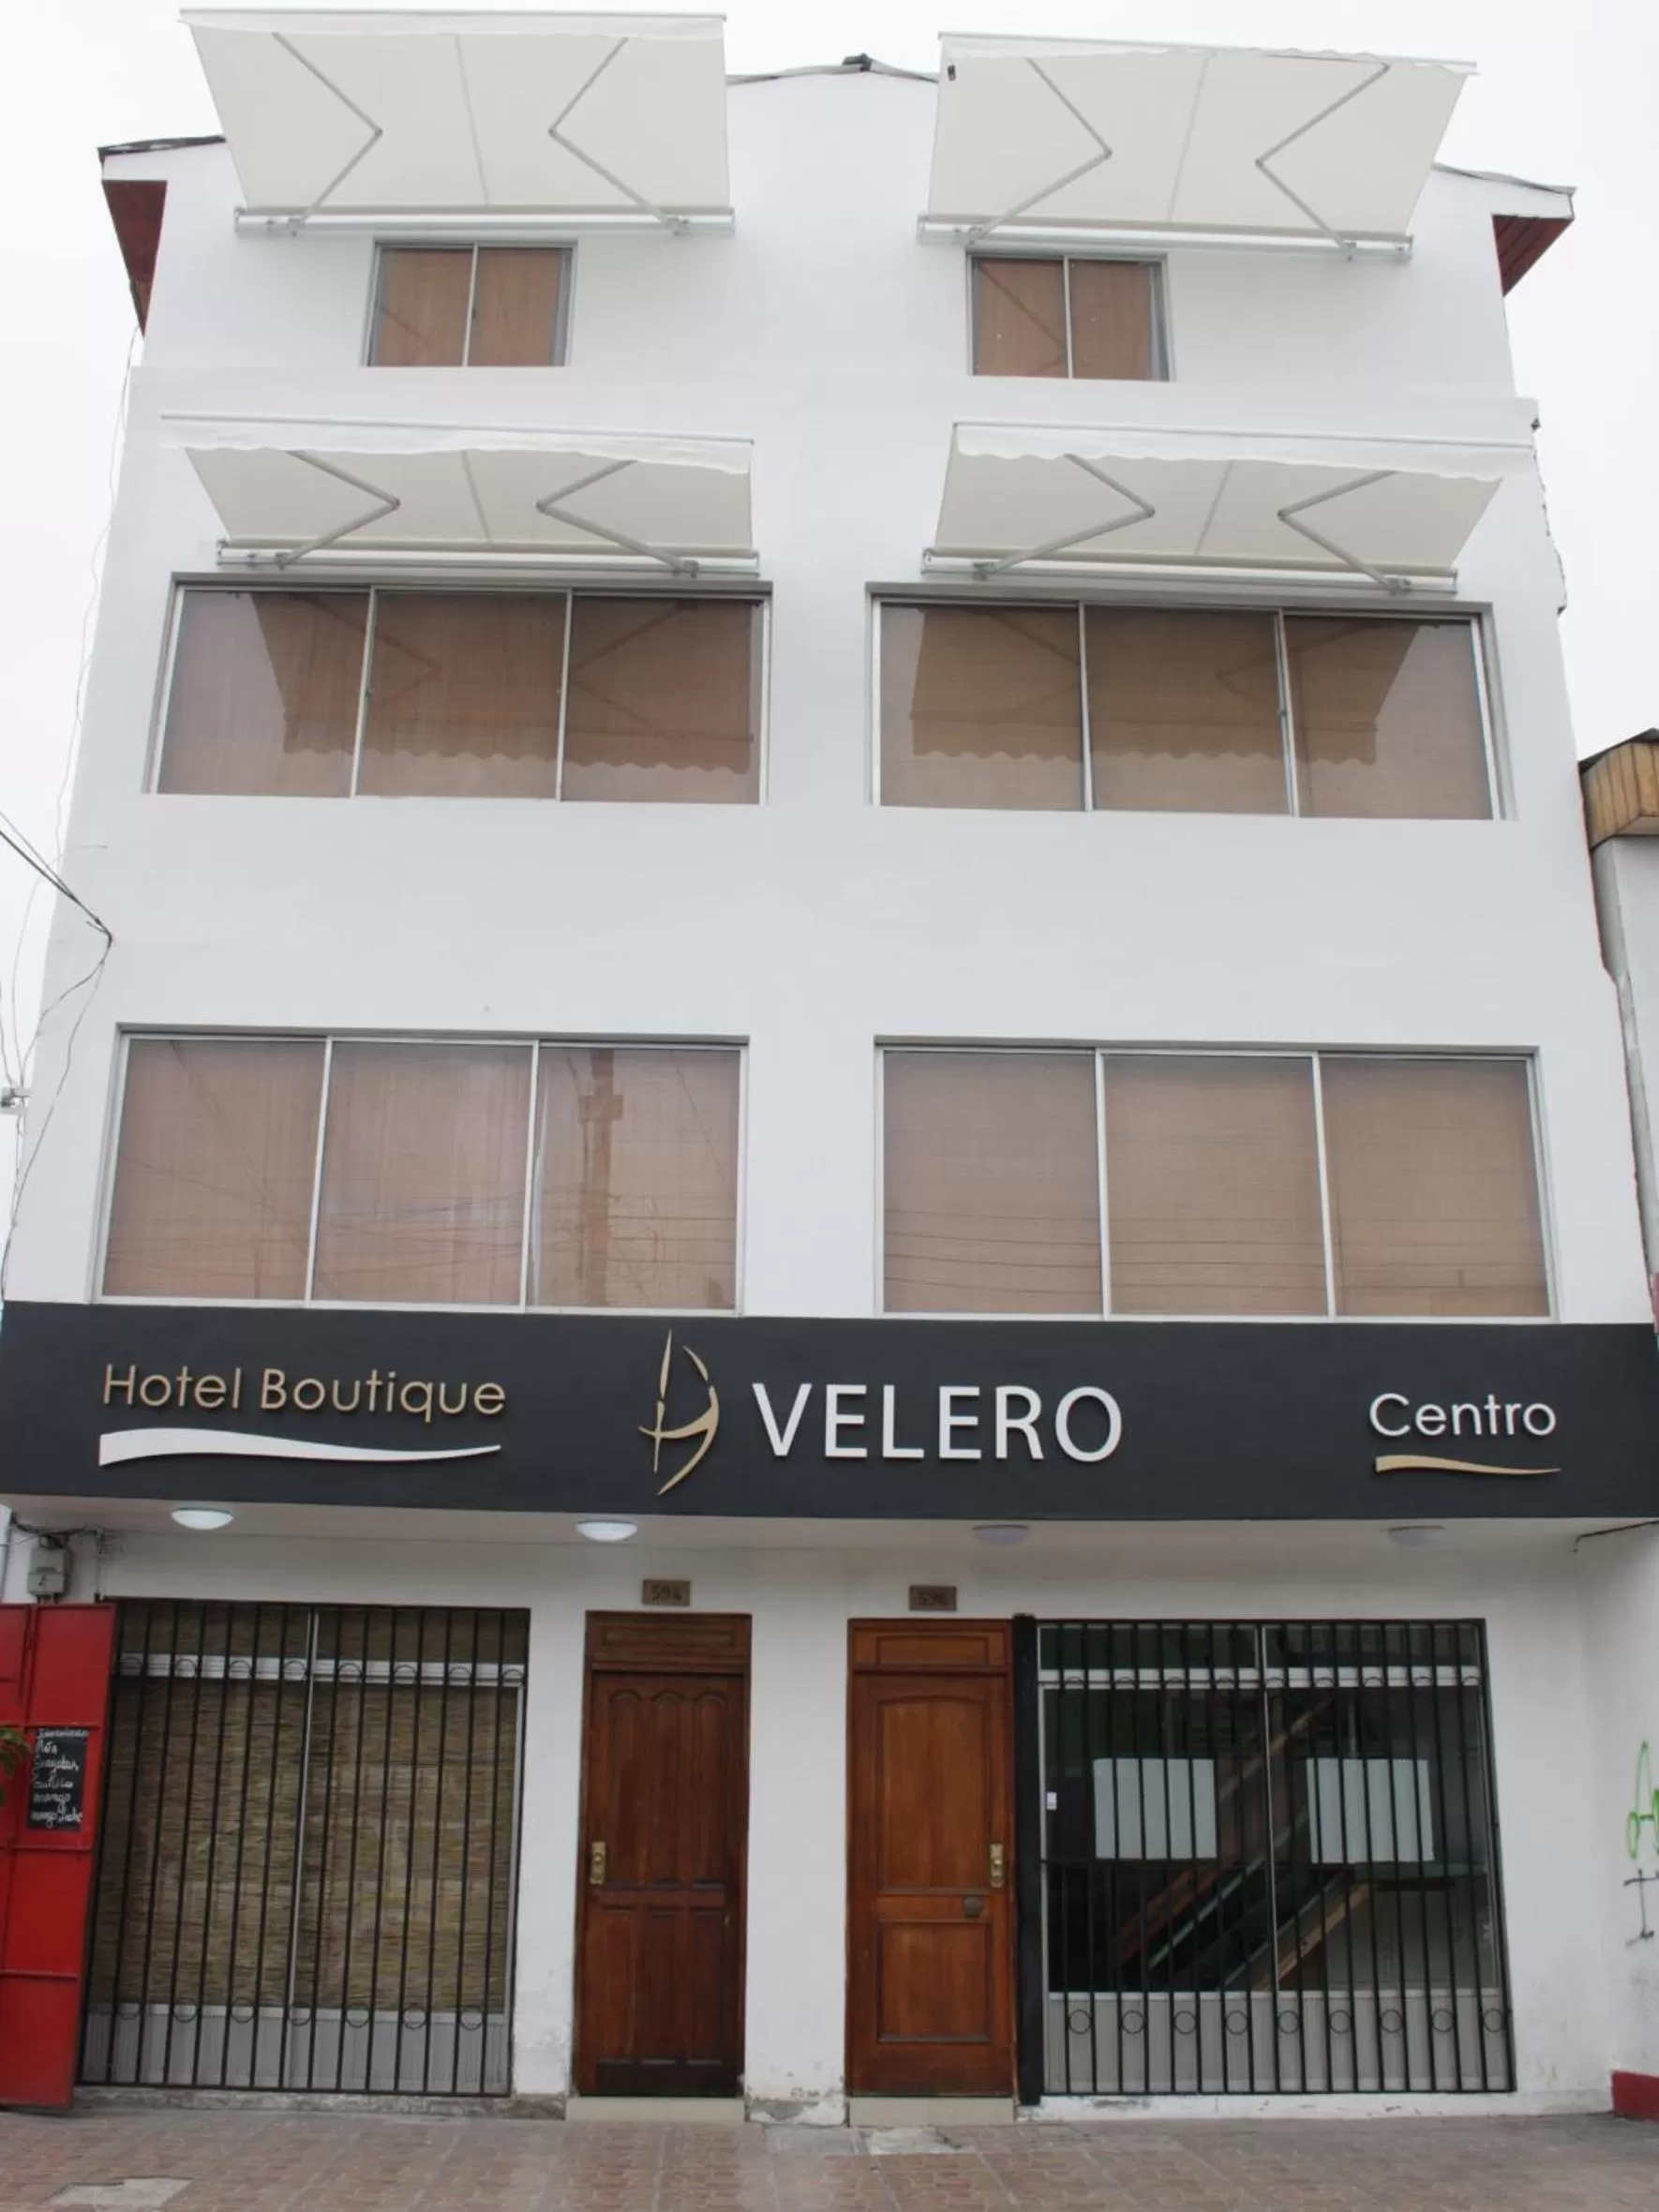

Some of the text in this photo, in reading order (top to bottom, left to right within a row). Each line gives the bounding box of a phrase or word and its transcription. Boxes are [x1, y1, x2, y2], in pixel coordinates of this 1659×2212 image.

[103, 1364, 507, 1423] Hotel Boutique
[752, 1382, 1123, 1462] VELERO
[1369, 1392, 1557, 1437] Centro
